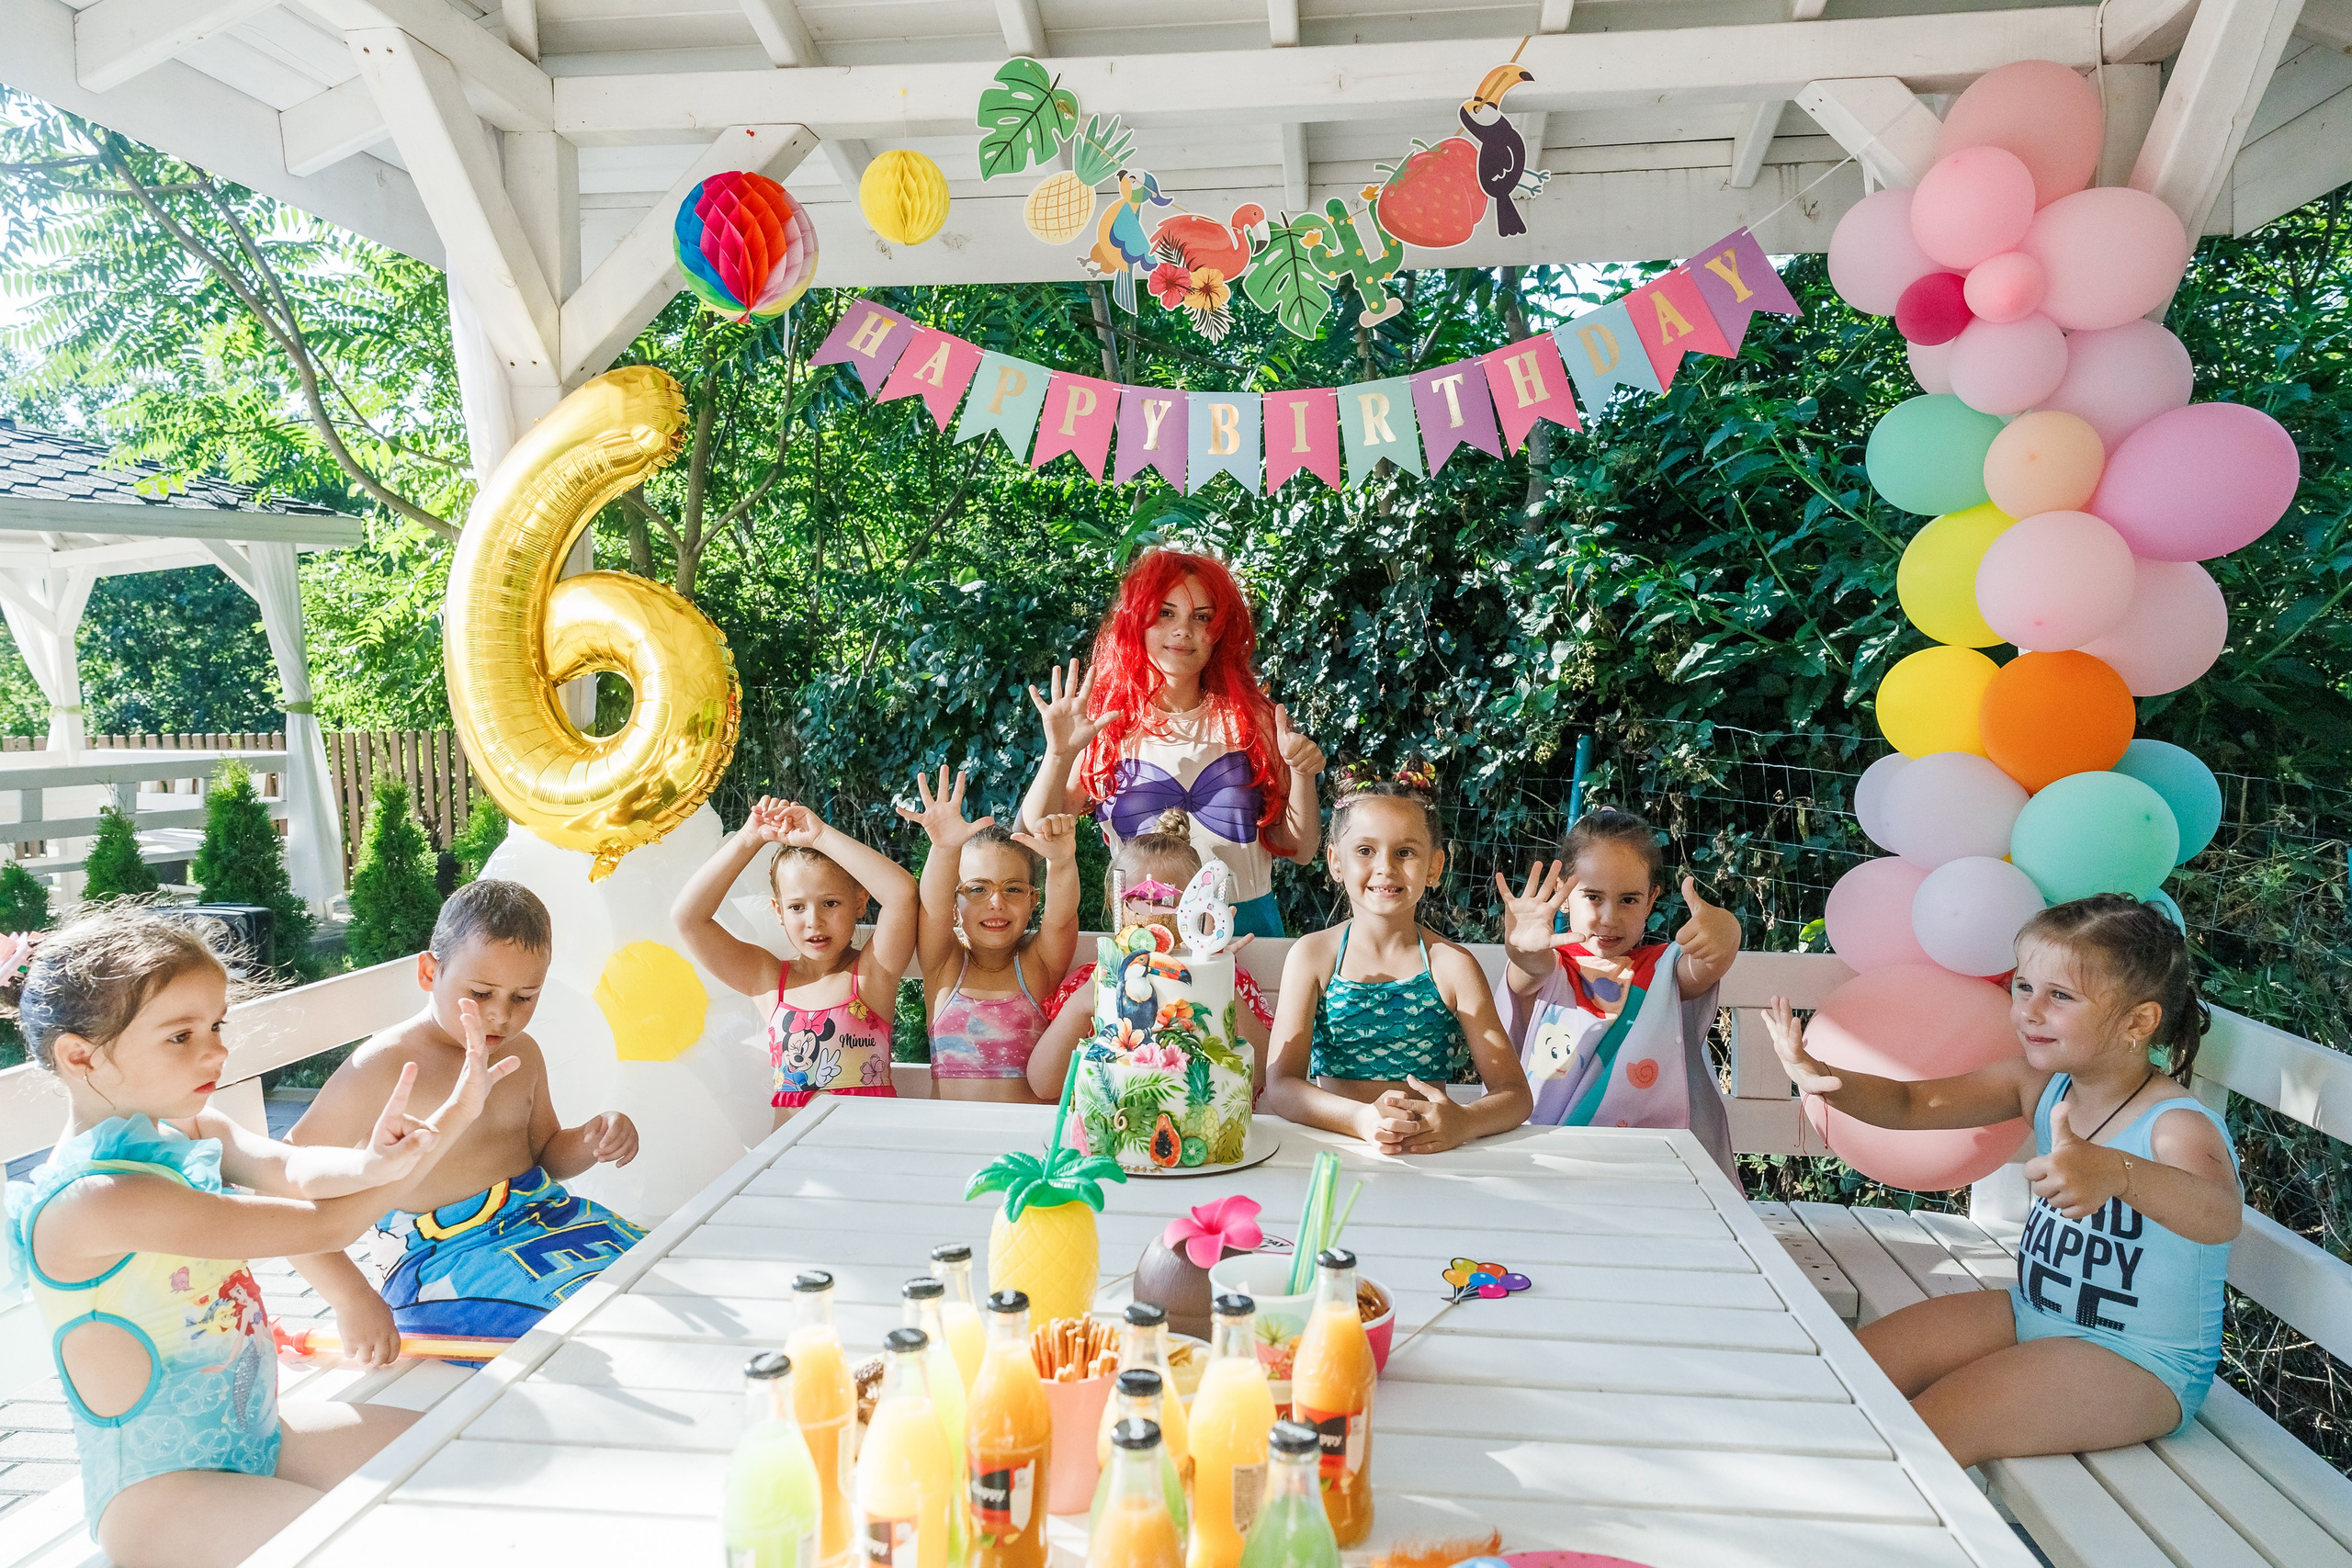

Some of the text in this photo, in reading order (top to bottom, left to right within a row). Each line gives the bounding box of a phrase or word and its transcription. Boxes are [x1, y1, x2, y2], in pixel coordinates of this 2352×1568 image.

[845, 246, 1755, 456] HAPPY BIRTHDAY
[445, 365, 743, 852] 6
[839, 1032, 876, 1049] Minnie
[2021, 1206, 2144, 1292] HAPPY
